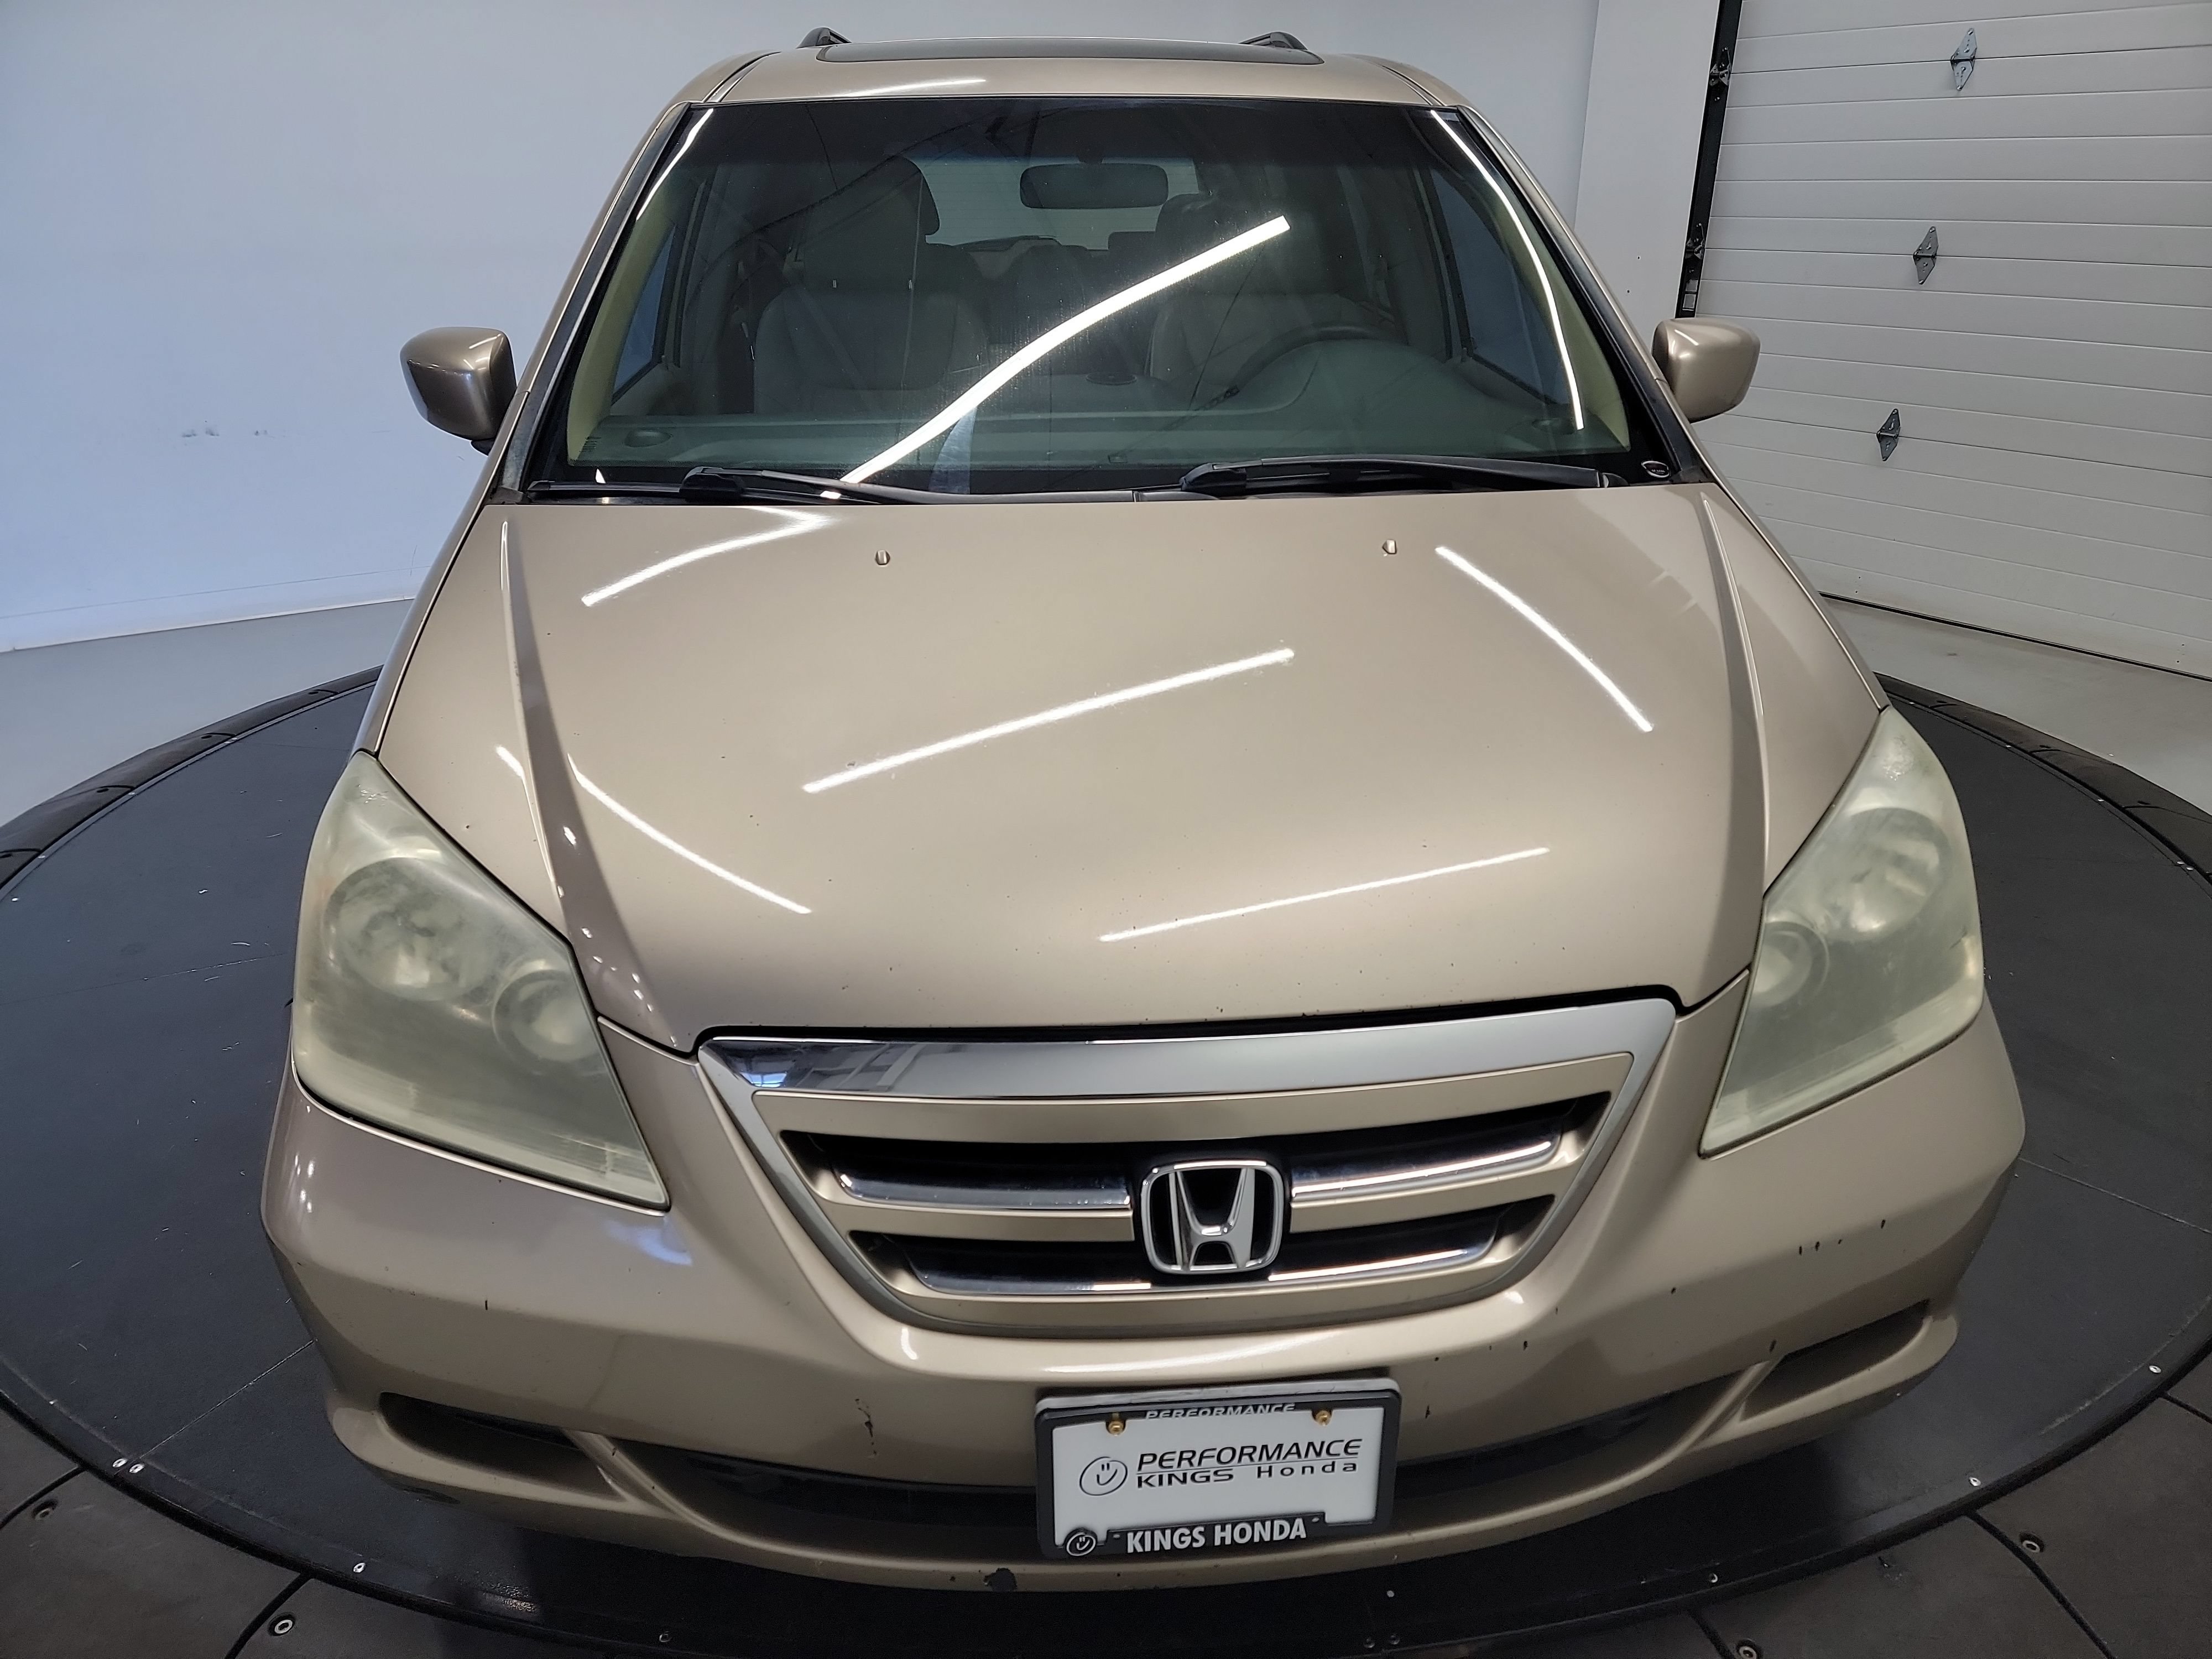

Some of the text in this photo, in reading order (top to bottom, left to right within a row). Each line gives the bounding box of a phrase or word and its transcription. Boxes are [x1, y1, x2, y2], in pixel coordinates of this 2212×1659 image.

[1145, 1403, 1296, 1420] PERFORMANCE
[1137, 1438, 1363, 1472] PERFORMANCE
[1137, 1460, 1357, 1489] KINGS Honda
[1127, 1517, 1307, 1553] KINGS HONDA
